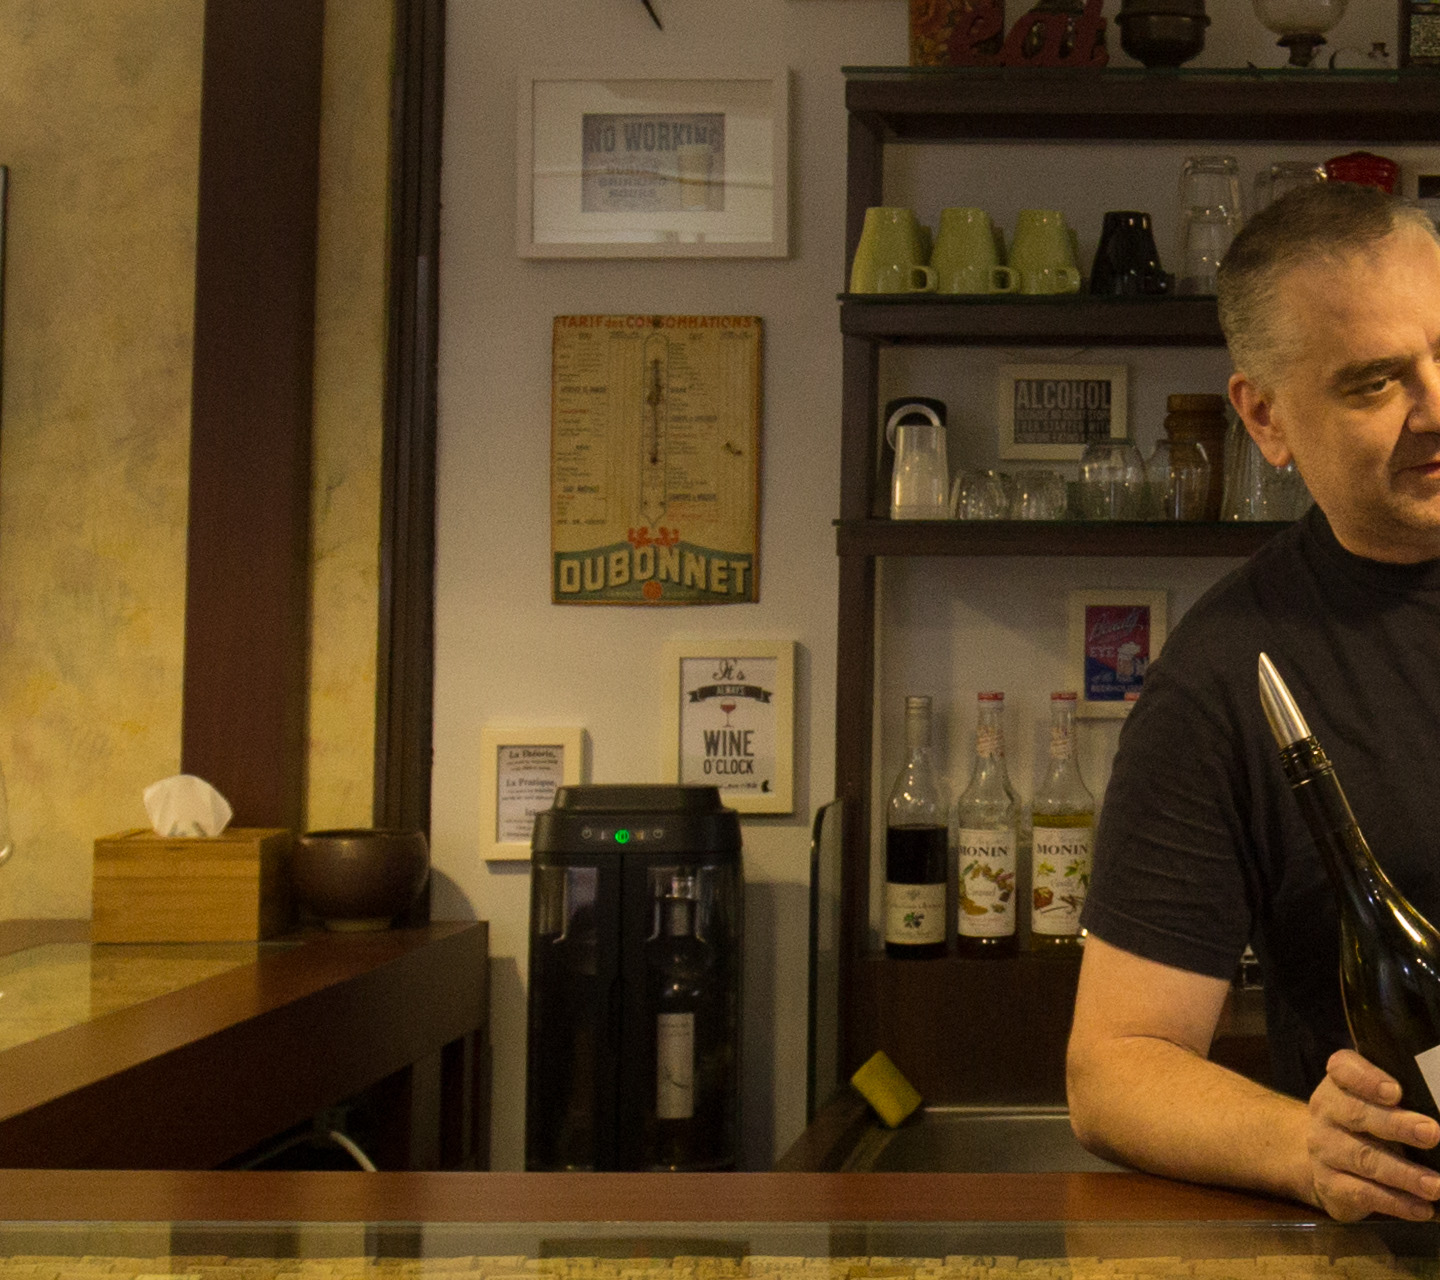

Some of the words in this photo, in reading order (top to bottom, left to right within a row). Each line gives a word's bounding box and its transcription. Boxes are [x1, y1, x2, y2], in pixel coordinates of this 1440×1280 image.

[588, 123, 616, 152] NO
[562, 316, 604, 328] TARIF
[1017, 381, 1111, 409] ALCOHOL
[560, 547, 749, 593] DUBONNET
[712, 658, 746, 681] It's
[717, 685, 744, 695] ALWAYS
[703, 729, 755, 757] WINE
[703, 758, 755, 774] O'CLOCK
[1037, 843, 1089, 856] MONIN
